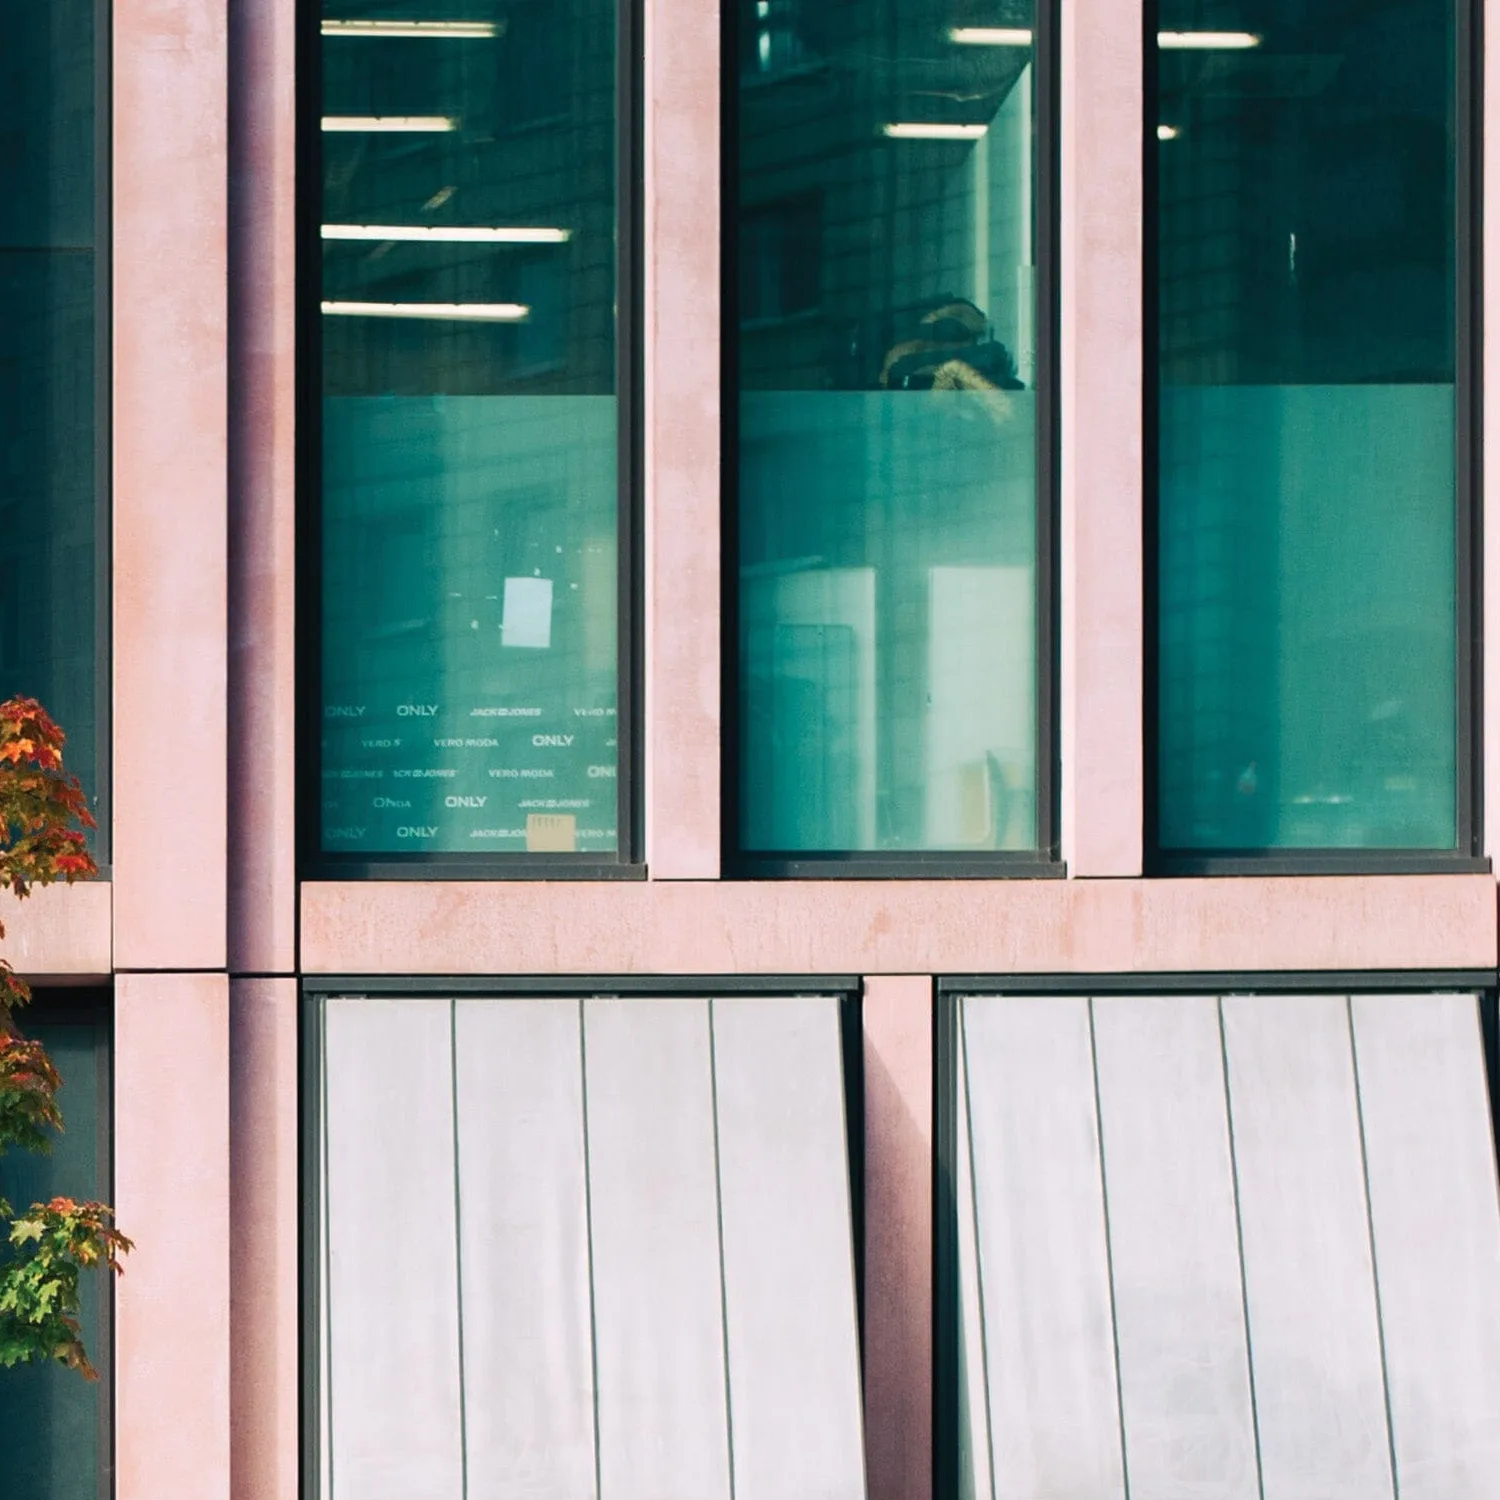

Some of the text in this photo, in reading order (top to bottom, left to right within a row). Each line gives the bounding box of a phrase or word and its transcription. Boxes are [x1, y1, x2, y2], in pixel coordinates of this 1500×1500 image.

[325, 705, 366, 716] ONLY
[396, 704, 439, 716] ONLY
[433, 738, 499, 748] VERO MODA
[532, 734, 574, 746] ONLY
[488, 769, 555, 778] VERO MODA
[444, 796, 487, 807] ONLY
[325, 827, 366, 839] ONLY
[396, 826, 439, 838] ONLY
